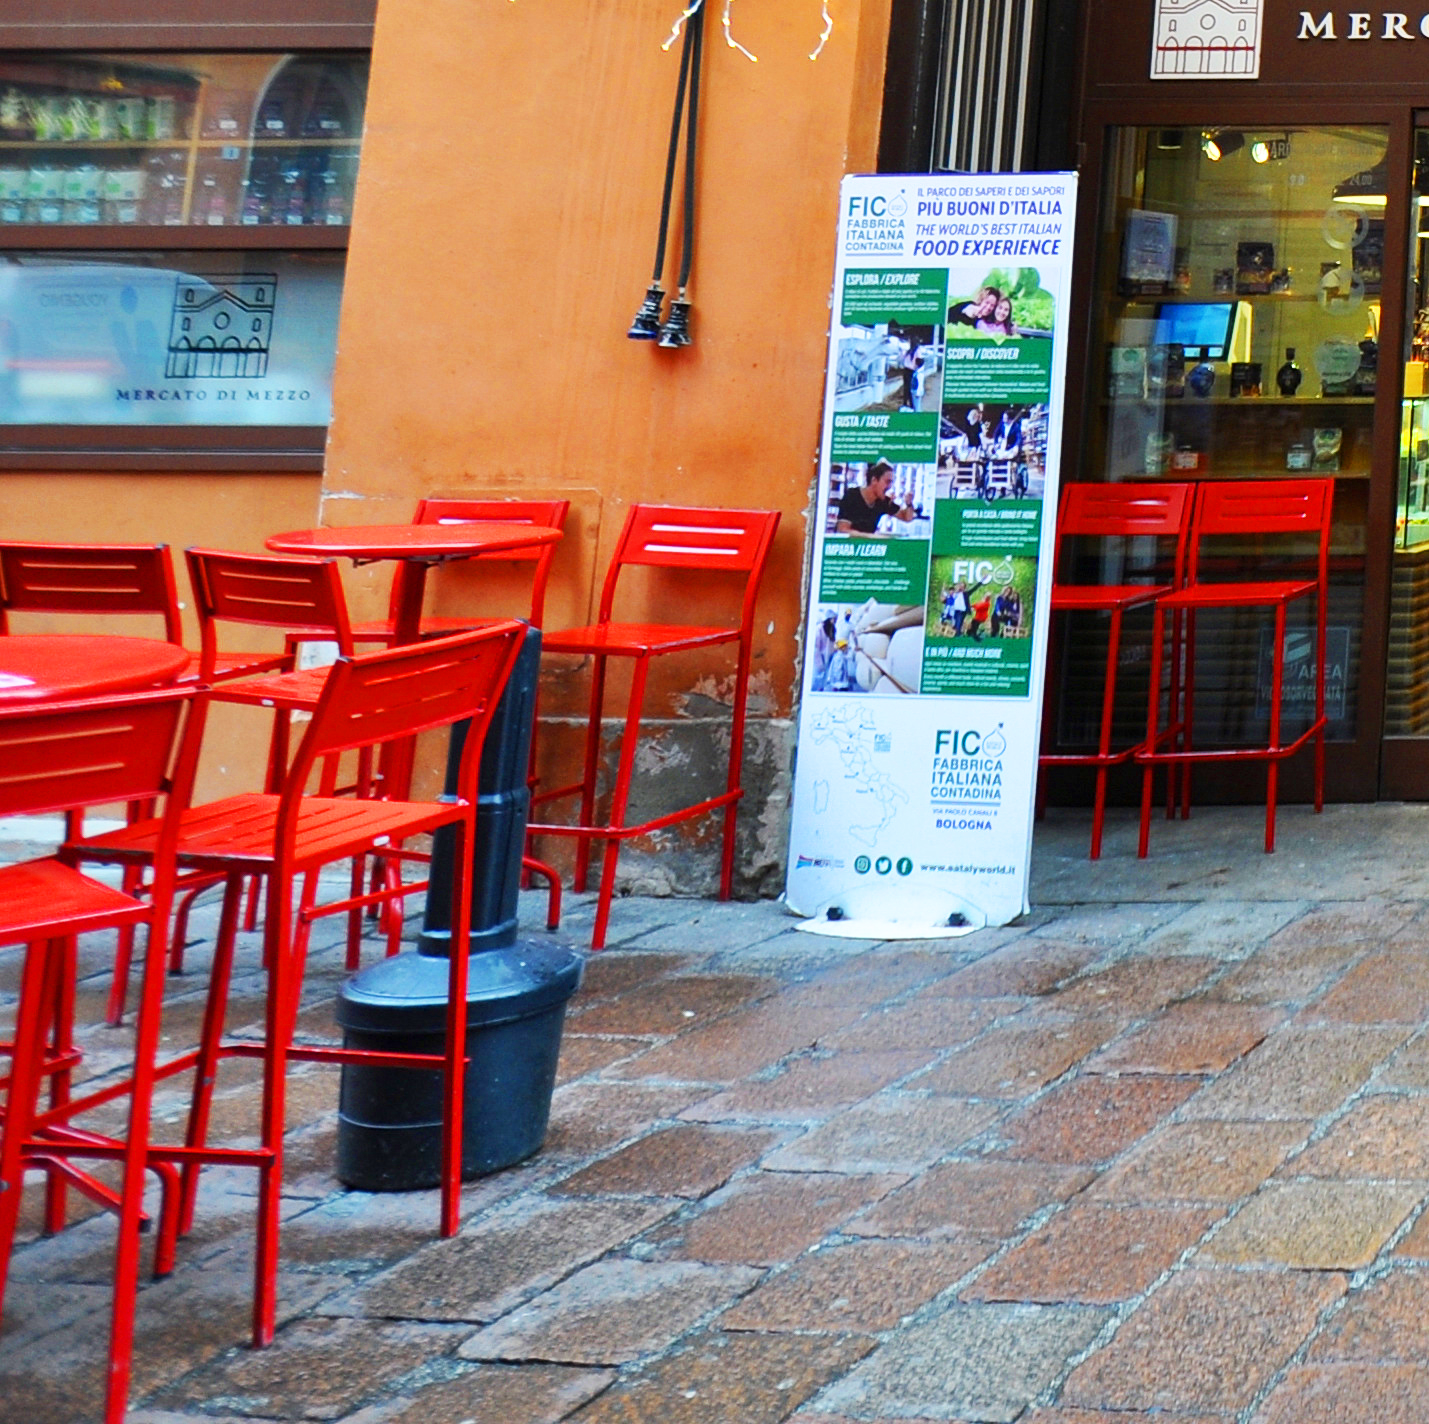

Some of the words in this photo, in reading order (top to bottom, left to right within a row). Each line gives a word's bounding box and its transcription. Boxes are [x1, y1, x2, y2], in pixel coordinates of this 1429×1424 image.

[926, 187, 957, 197] PARCO
[958, 187, 973, 197] DEI
[974, 186, 1006, 197] SAPERI
[1015, 186, 1030, 196] DEI
[1032, 186, 1065, 196] SAPORI
[917, 197, 943, 217] PIÙ
[946, 200, 995, 217] BUONI
[999, 200, 1063, 216] D'ITALIA
[847, 218, 905, 229] FABBRICA
[915, 223, 936, 236] THE
[938, 223, 988, 236] WORLD'S
[990, 223, 1017, 236] BEST
[1018, 222, 1062, 236] ITALIAN
[846, 229, 905, 241] ITALIANA
[845, 242, 905, 252] CONTADINA
[913, 240, 959, 257] FOOD
[961, 239, 1062, 256] EXPERIENCE
[116, 389, 207, 401] MERCATO
[217, 389, 236, 401] DI
[246, 389, 311, 401] MEZZO
[933, 758, 1003, 772] FABBRICA
[931, 771, 1002, 786] ITALIANA
[930, 786, 1002, 799] CONTADINA
[935, 819, 992, 831] BOLOGNA
